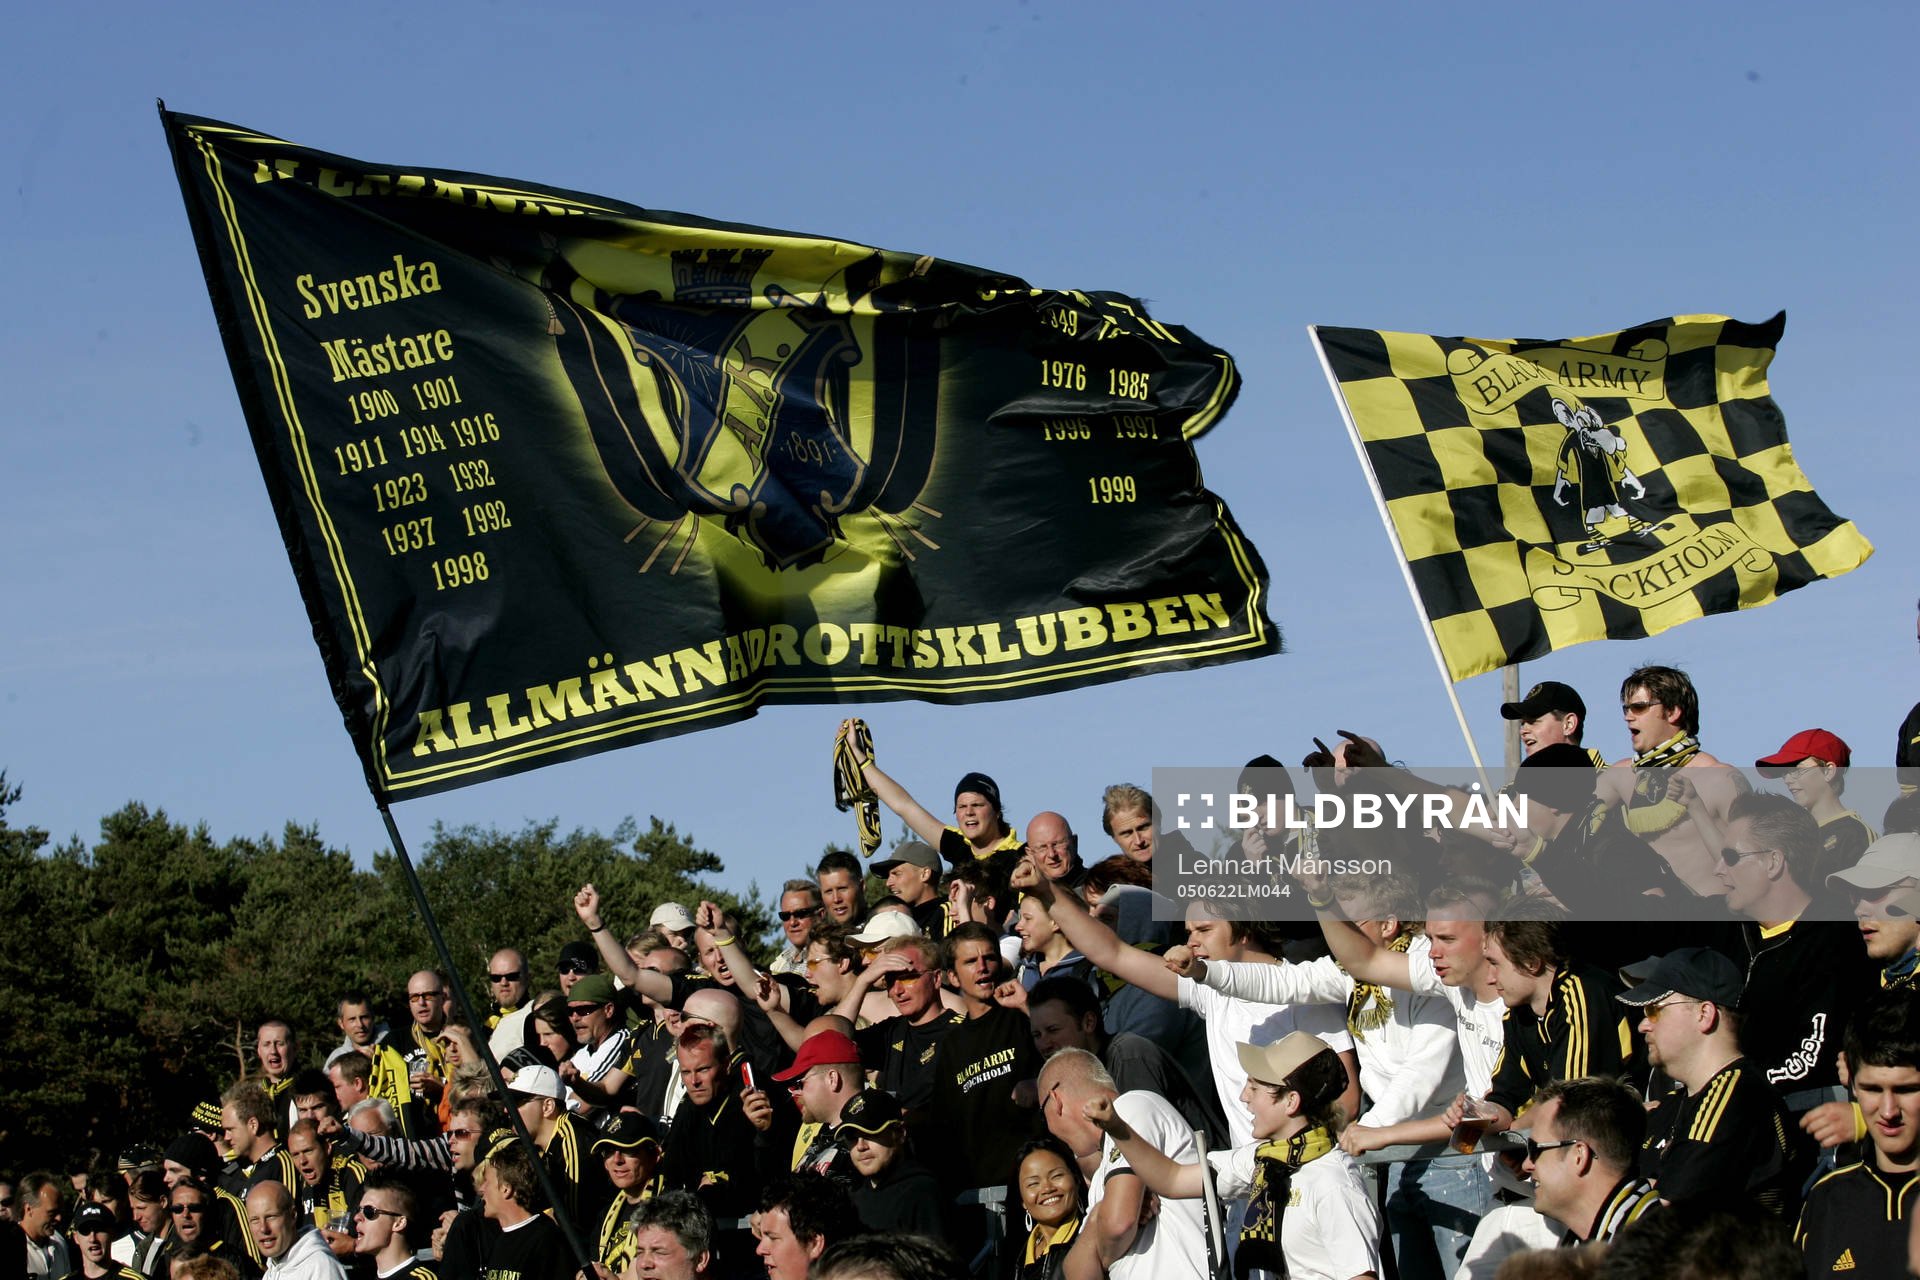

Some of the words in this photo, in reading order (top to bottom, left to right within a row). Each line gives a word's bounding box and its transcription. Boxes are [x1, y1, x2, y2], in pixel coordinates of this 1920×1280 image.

[296, 254, 442, 320] Svenska
[319, 329, 456, 383] Mästare
[1041, 359, 1087, 391] 1976
[1108, 368, 1150, 401] 1985
[348, 388, 400, 424] 1900
[412, 375, 462, 411] 1901
[1472, 359, 1552, 407] BLACK
[1558, 360, 1651, 394] ARMY
[334, 435, 389, 476] 1911
[399, 424, 447, 459] 1914
[450, 412, 500, 448] 1916
[1040, 417, 1091, 441] 1996
[1112, 415, 1159, 440] 1997
[372, 472, 428, 513] 1923
[448, 459, 496, 493] 1932
[1088, 475, 1137, 504] 1999
[382, 516, 436, 556] 1937
[462, 500, 512, 537] 1992
[431, 551, 489, 591] 1998
[956, 1060, 981, 1085] BLACK
[983, 1047, 1016, 1070] ARMY
[962, 1063, 1012, 1093] STOCKHOLM
